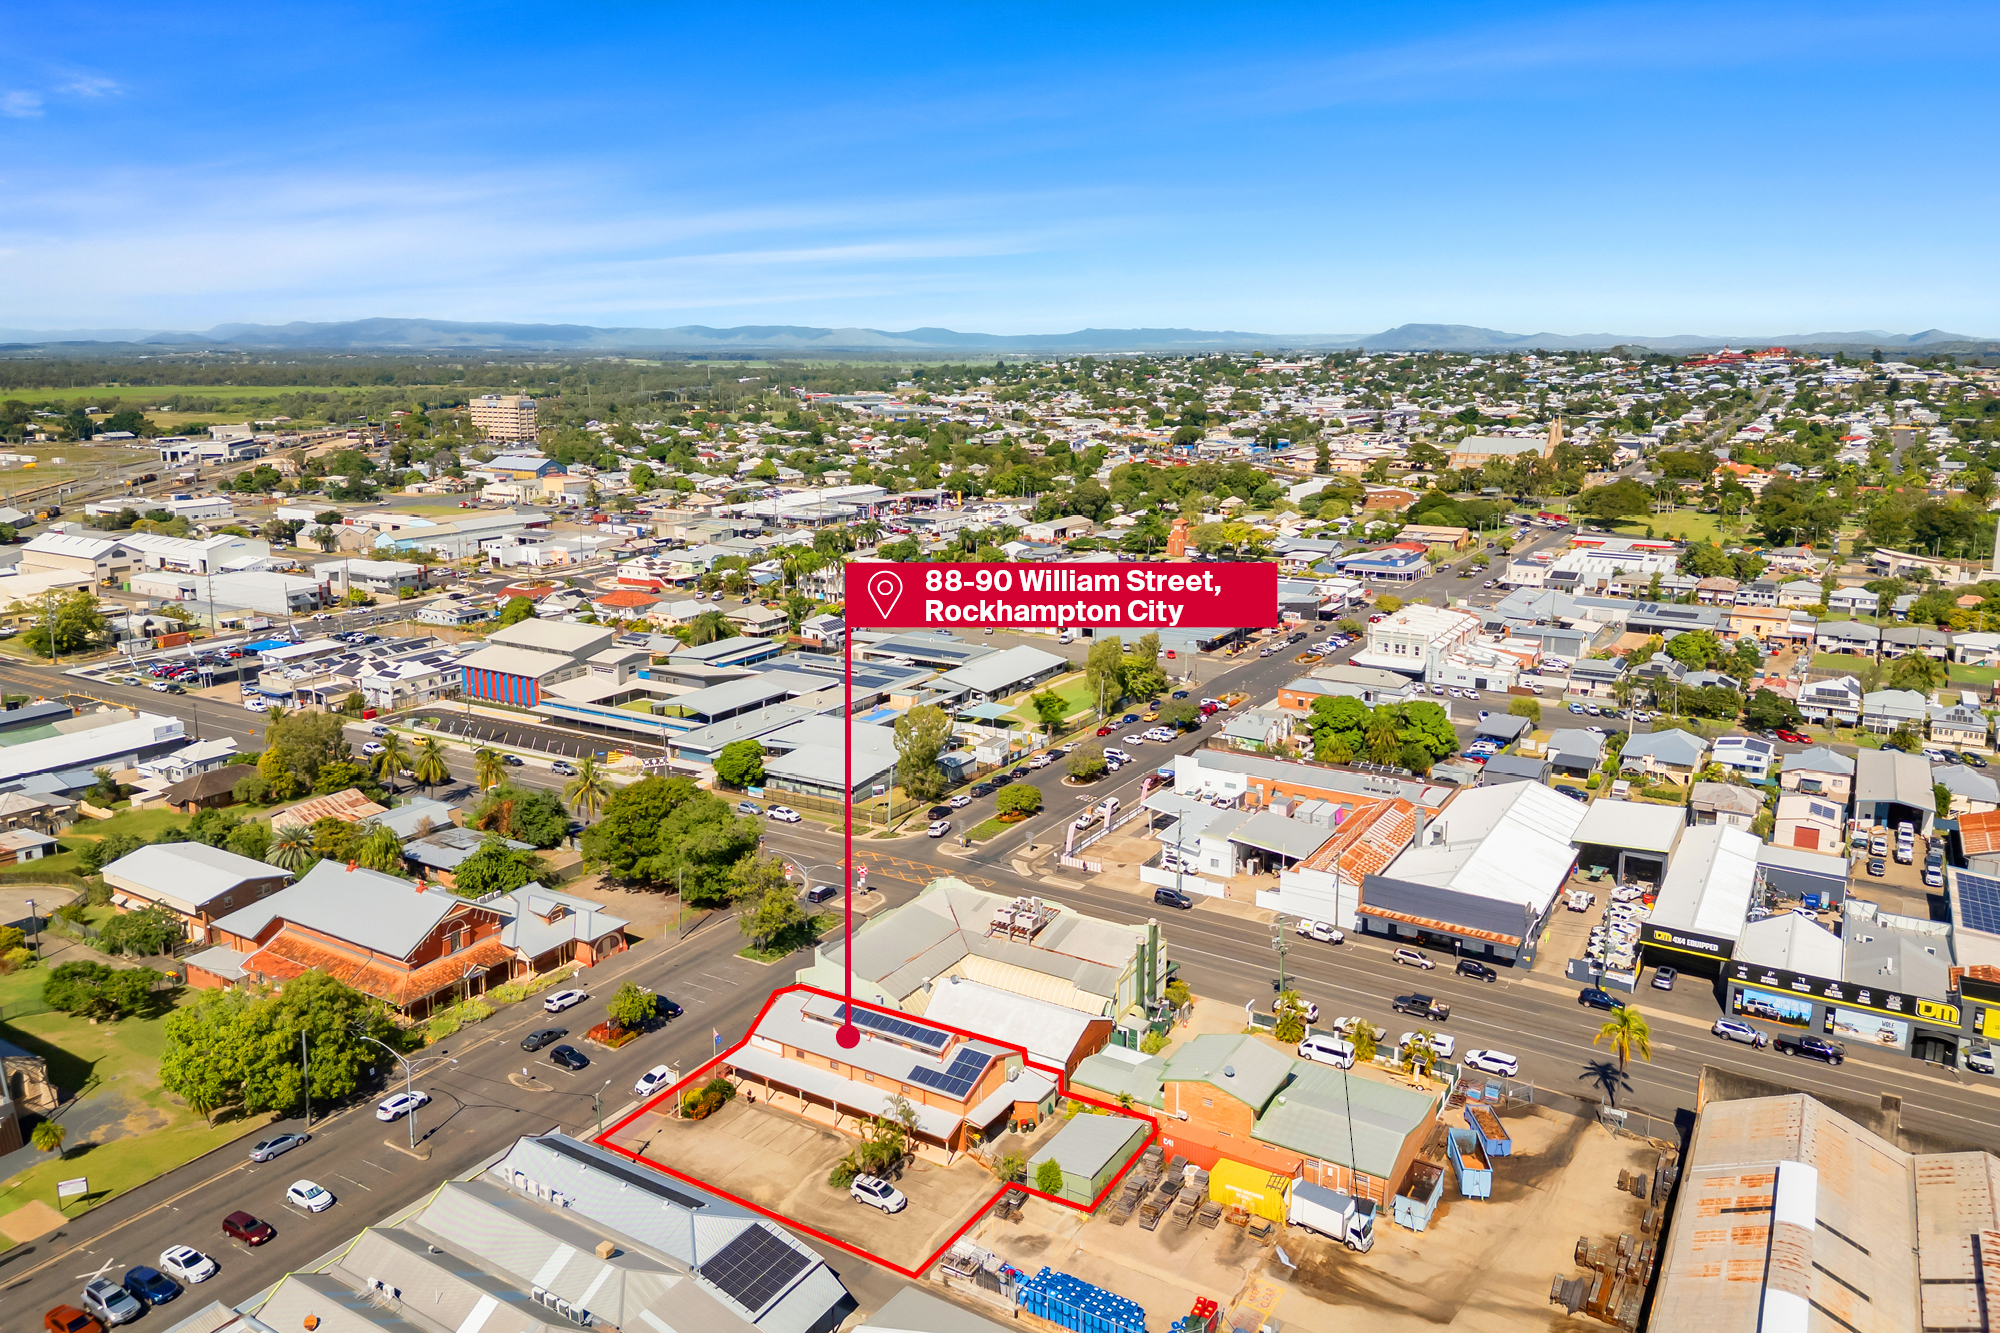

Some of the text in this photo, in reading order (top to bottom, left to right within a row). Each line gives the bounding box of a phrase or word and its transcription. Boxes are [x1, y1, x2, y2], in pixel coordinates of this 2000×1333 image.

[1672, 936, 1686, 945] 4X4
[1686, 939, 1719, 952] EQUIPPED
[1260, 1287, 1276, 1308] CLEAR
